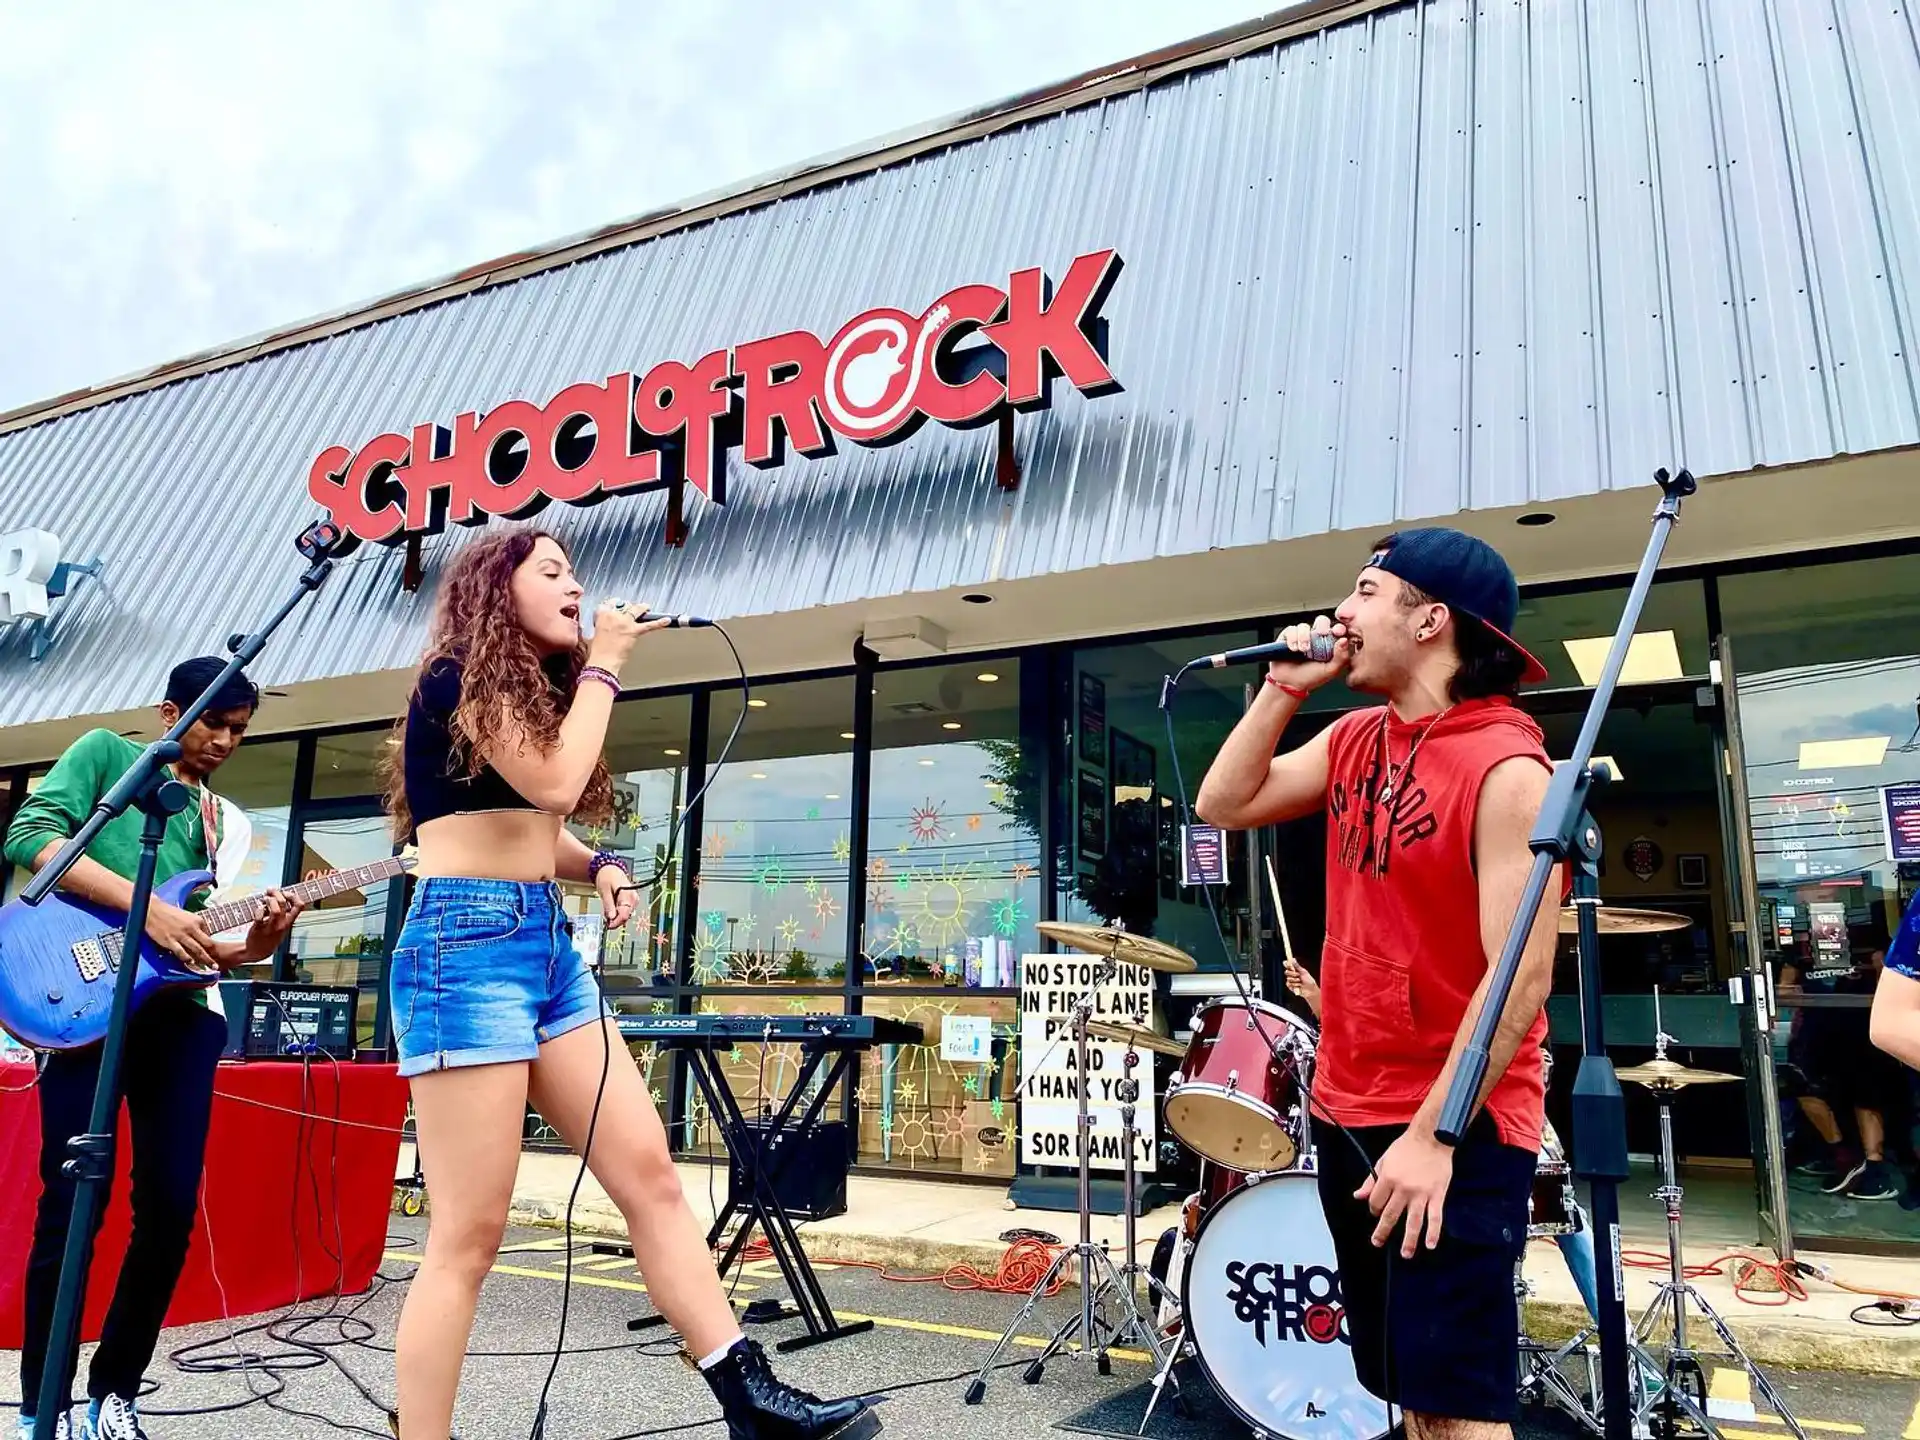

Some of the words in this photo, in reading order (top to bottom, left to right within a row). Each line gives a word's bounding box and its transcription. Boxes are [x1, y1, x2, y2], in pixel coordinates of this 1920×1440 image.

[307, 372, 661, 552] SCHOOL
[735, 247, 1120, 464] ROCK
[1026, 963, 1049, 985] NO
[1023, 991, 1040, 1013] IN
[1096, 992, 1149, 1014] LANE
[1046, 1020, 1120, 1042] PLE
[1032, 1132, 1069, 1157] SOR
